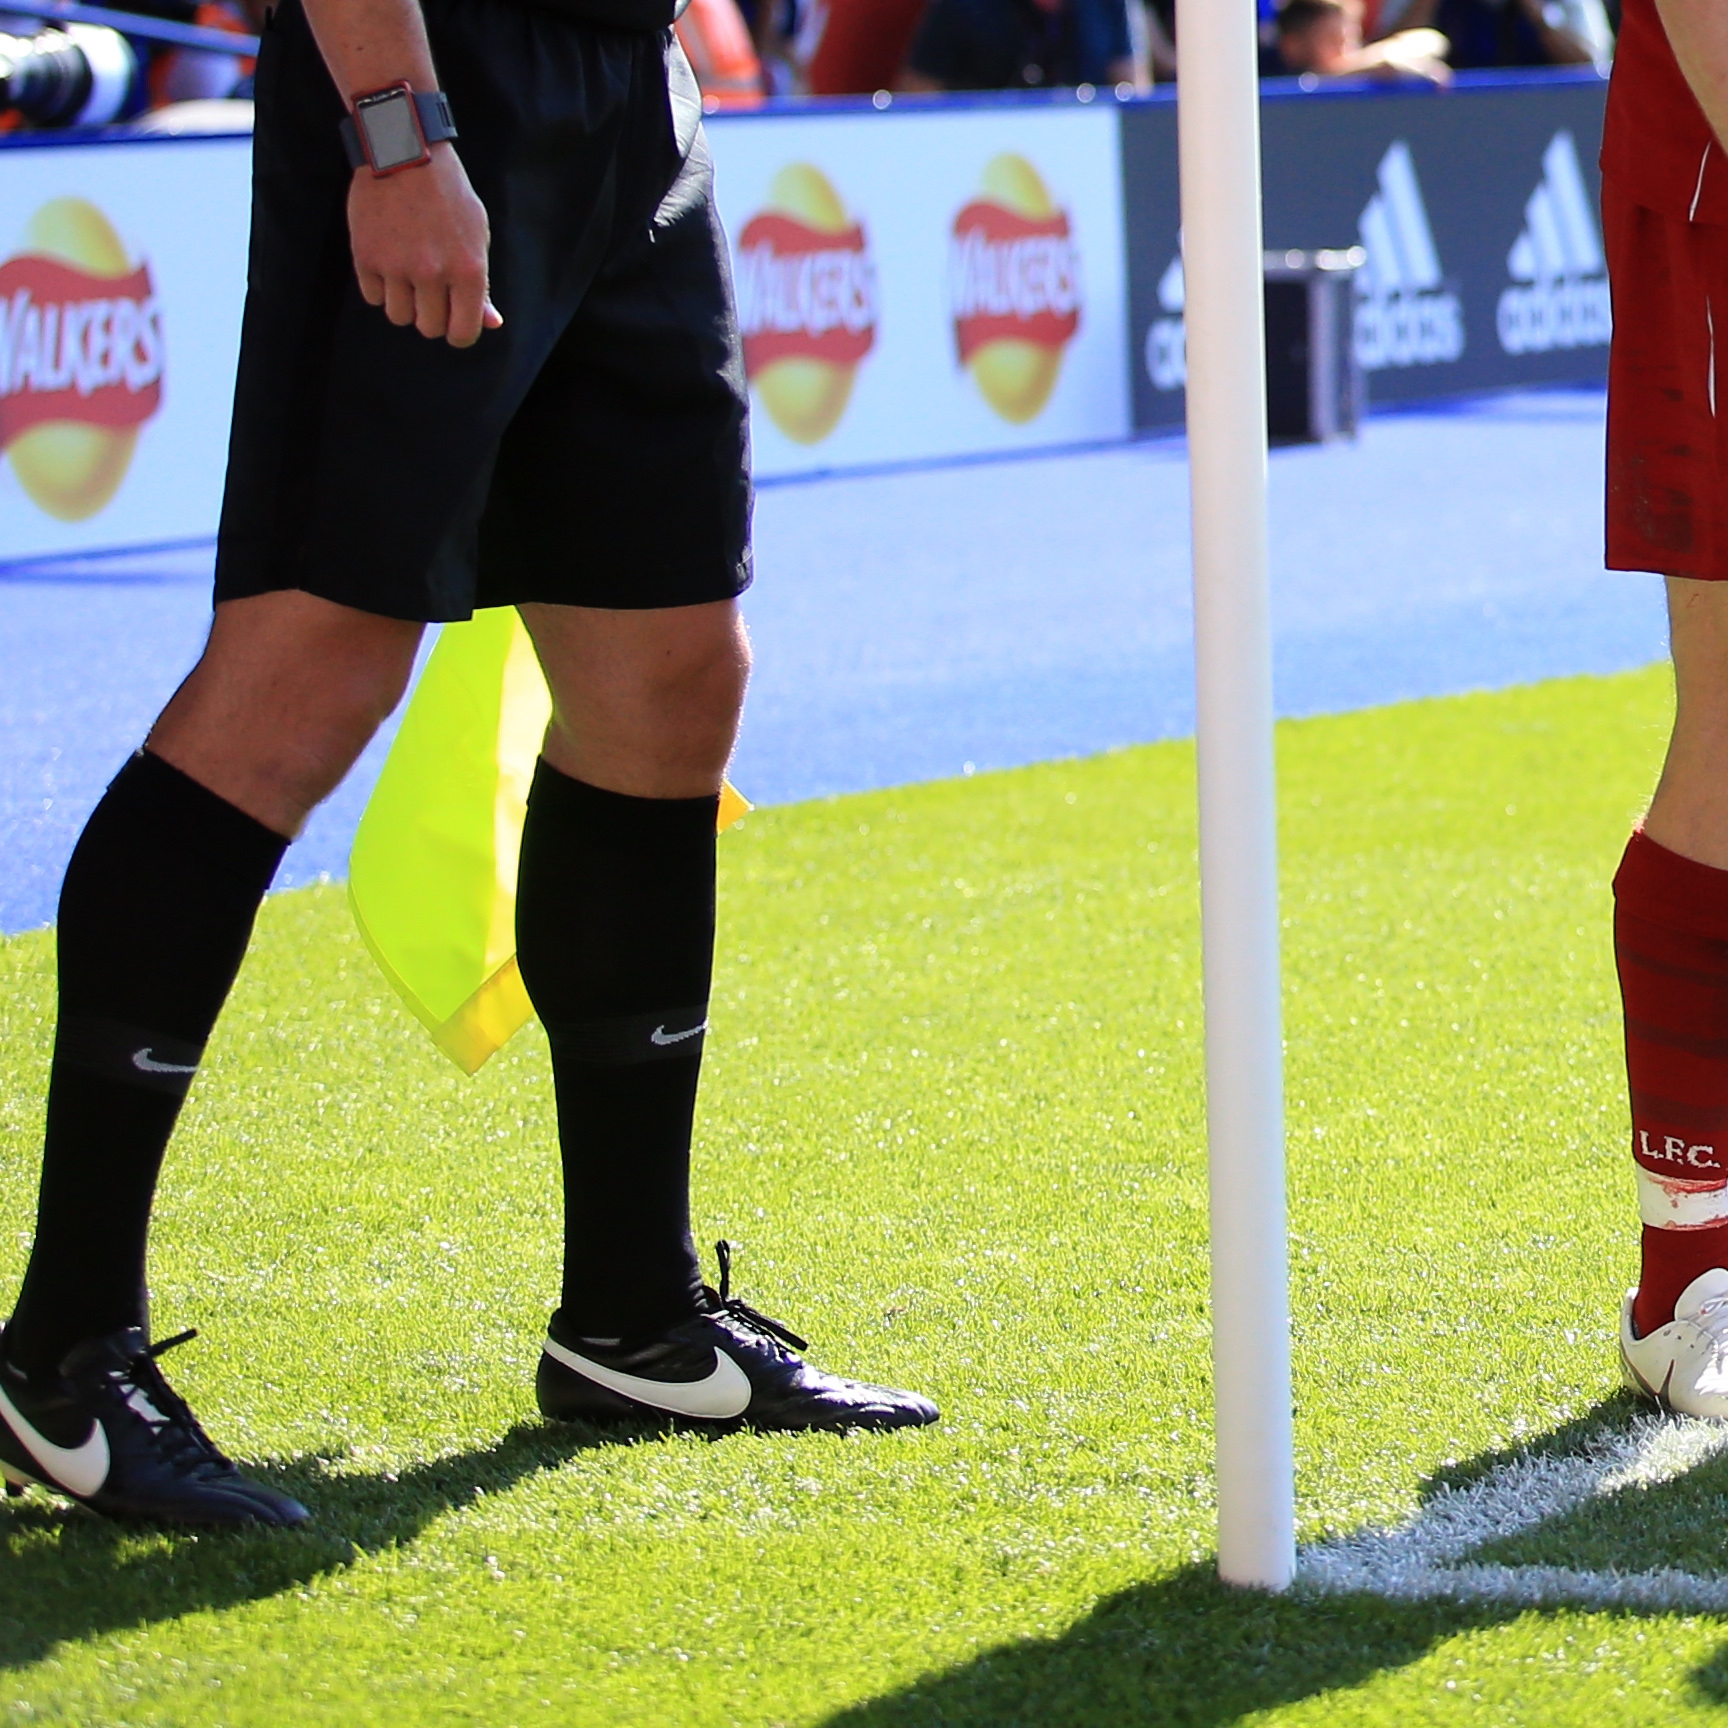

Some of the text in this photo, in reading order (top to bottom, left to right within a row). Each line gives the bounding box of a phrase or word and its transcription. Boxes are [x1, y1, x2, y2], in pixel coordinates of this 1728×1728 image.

[737, 238, 880, 339] WALKERS
[950, 224, 1084, 321] WALKERS
[1354, 288, 1466, 370] didas
[1639, 1129, 1721, 1169] L.F.C.
